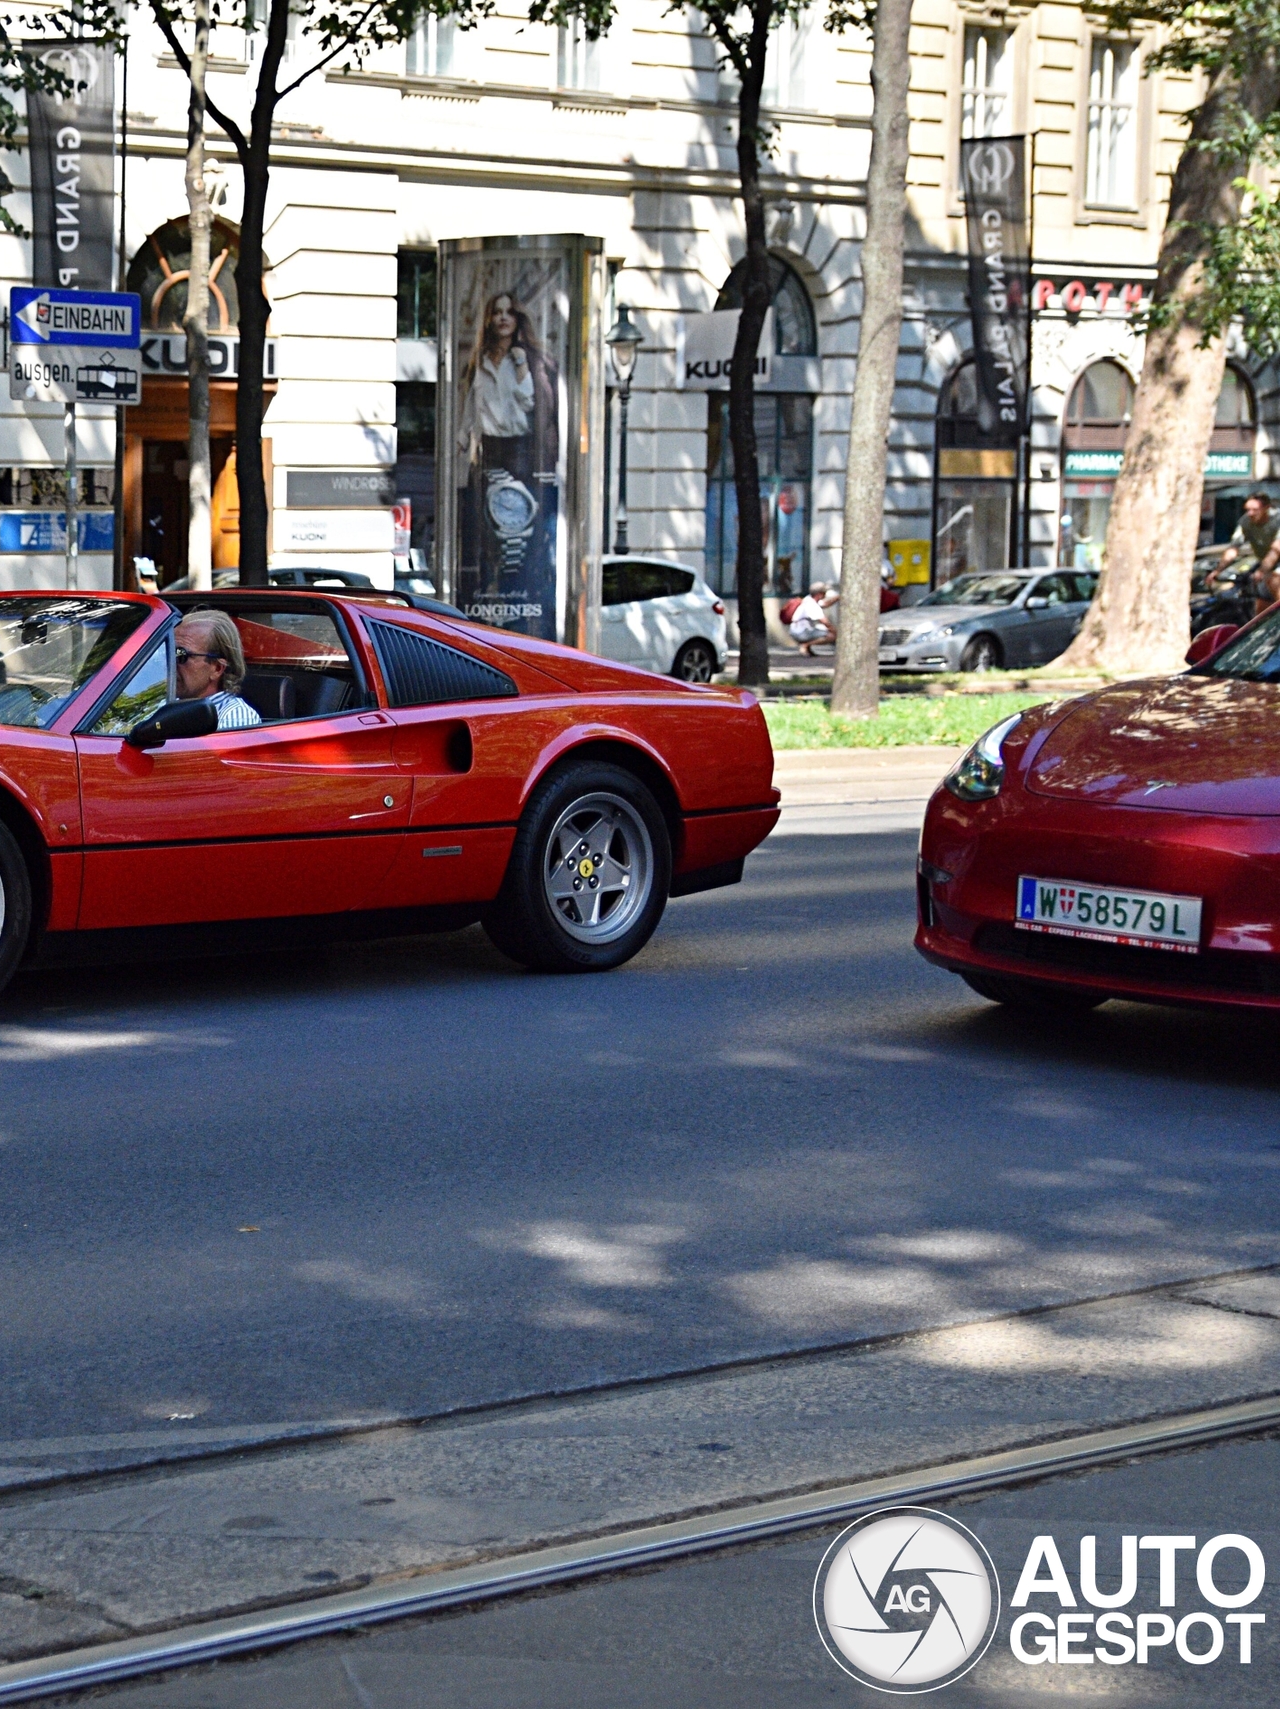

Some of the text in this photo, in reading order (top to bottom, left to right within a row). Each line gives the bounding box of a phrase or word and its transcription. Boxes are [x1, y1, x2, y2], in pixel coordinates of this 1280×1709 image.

[1008, 279, 1144, 312] APOTH
[53, 307, 125, 332] EINBAHN
[140, 339, 275, 375] KUOI
[686, 357, 766, 379] KUI
[14, 361, 75, 388] ausgen.
[1065, 454, 1124, 471] PHARMAC
[1204, 455, 1249, 472] OTHEKE
[331, 476, 389, 490] WINDROS
[291, 533, 326, 541] KUONI
[464, 603, 542, 617] LONGINES
[1040, 887, 1058, 918] W
